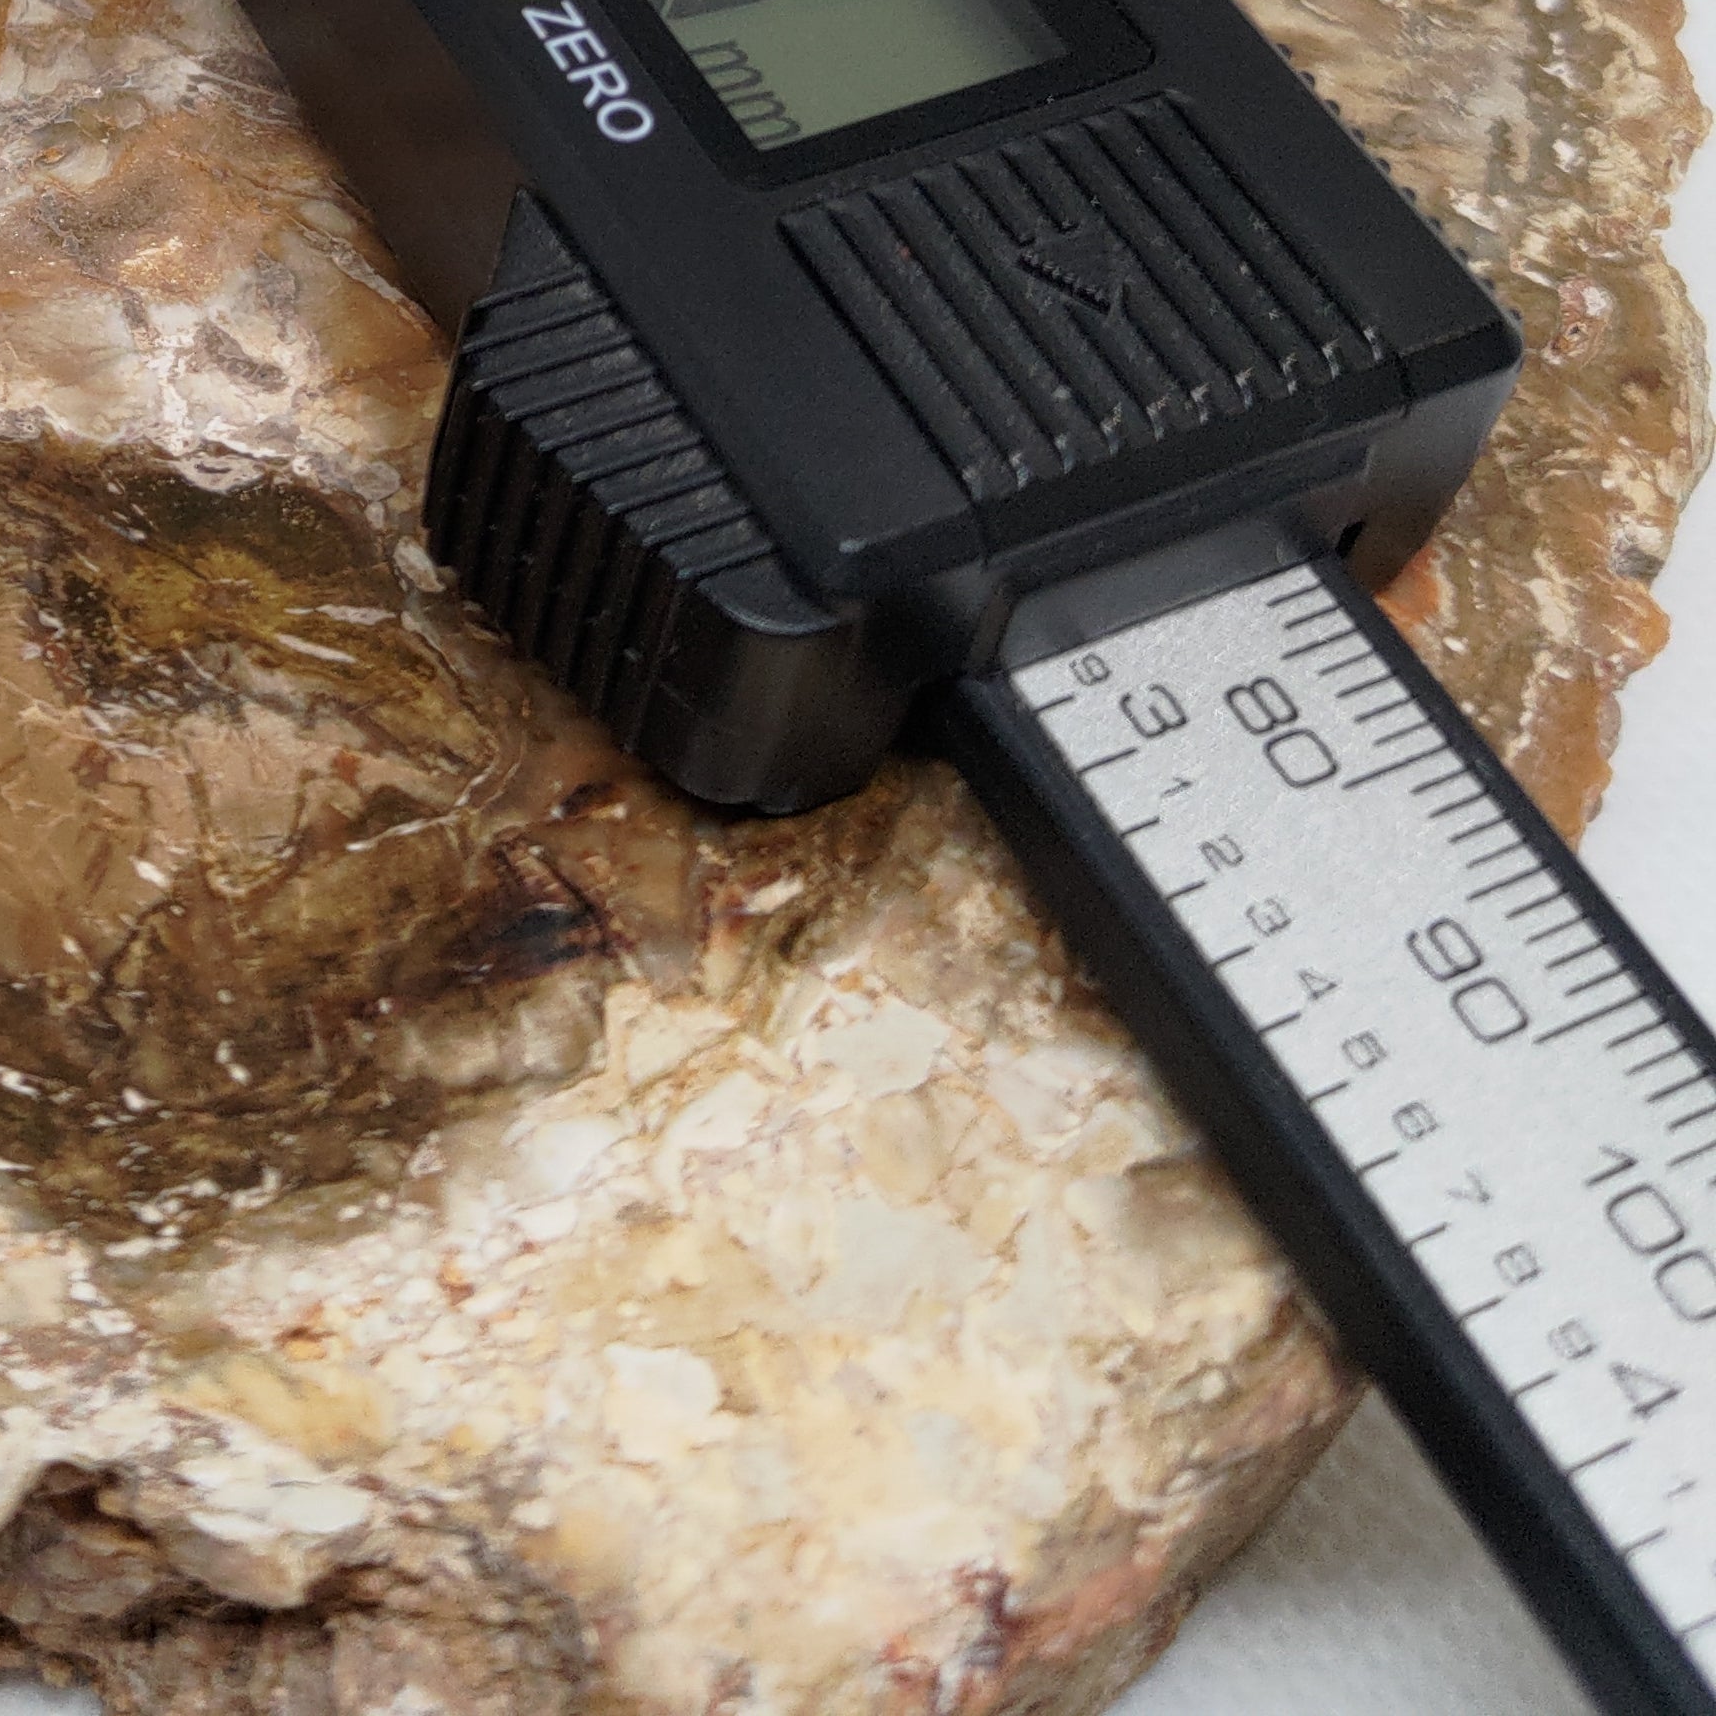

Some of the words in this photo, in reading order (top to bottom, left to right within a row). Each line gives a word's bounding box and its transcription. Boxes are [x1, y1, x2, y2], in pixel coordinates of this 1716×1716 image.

[520, 0, 655, 144] ZERO
[688, 37, 804, 150] mm
[1119, 683, 1190, 740] 3
[1223, 675, 1341, 790] 80
[1159, 776, 1193, 798] 1
[1197, 834, 1244, 873] 2
[1244, 895, 1292, 938] 3
[1296, 967, 1340, 1002] 4
[1404, 915, 1529, 1044] 90
[1340, 1030, 1388, 1070] 5
[1391, 1101, 1440, 1142] 6
[1445, 1166, 1492, 1205] 7
[1583, 1144, 1716, 1322] 100
[1492, 1242, 1544, 1286] 8
[1608, 1361, 1684, 1419] 4
